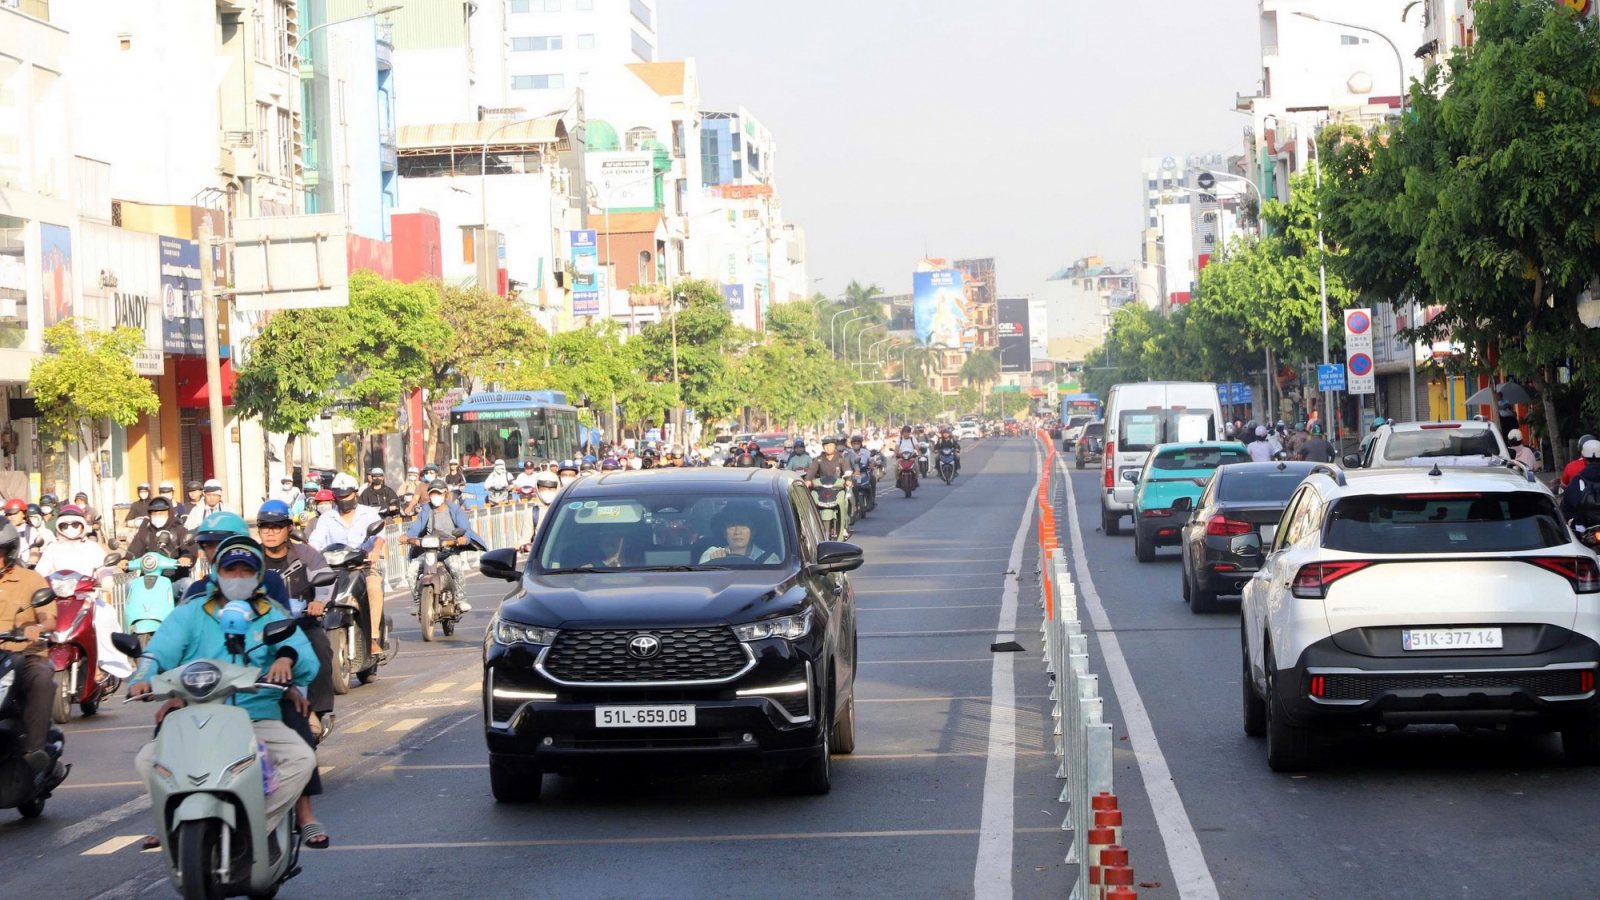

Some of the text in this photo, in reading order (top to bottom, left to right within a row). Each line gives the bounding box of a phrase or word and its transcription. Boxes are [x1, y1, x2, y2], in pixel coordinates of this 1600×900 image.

[114, 292, 148, 330] DANDY
[1411, 631, 1494, 645] 51K-377.14
[604, 709, 687, 723] 51L-659.08
